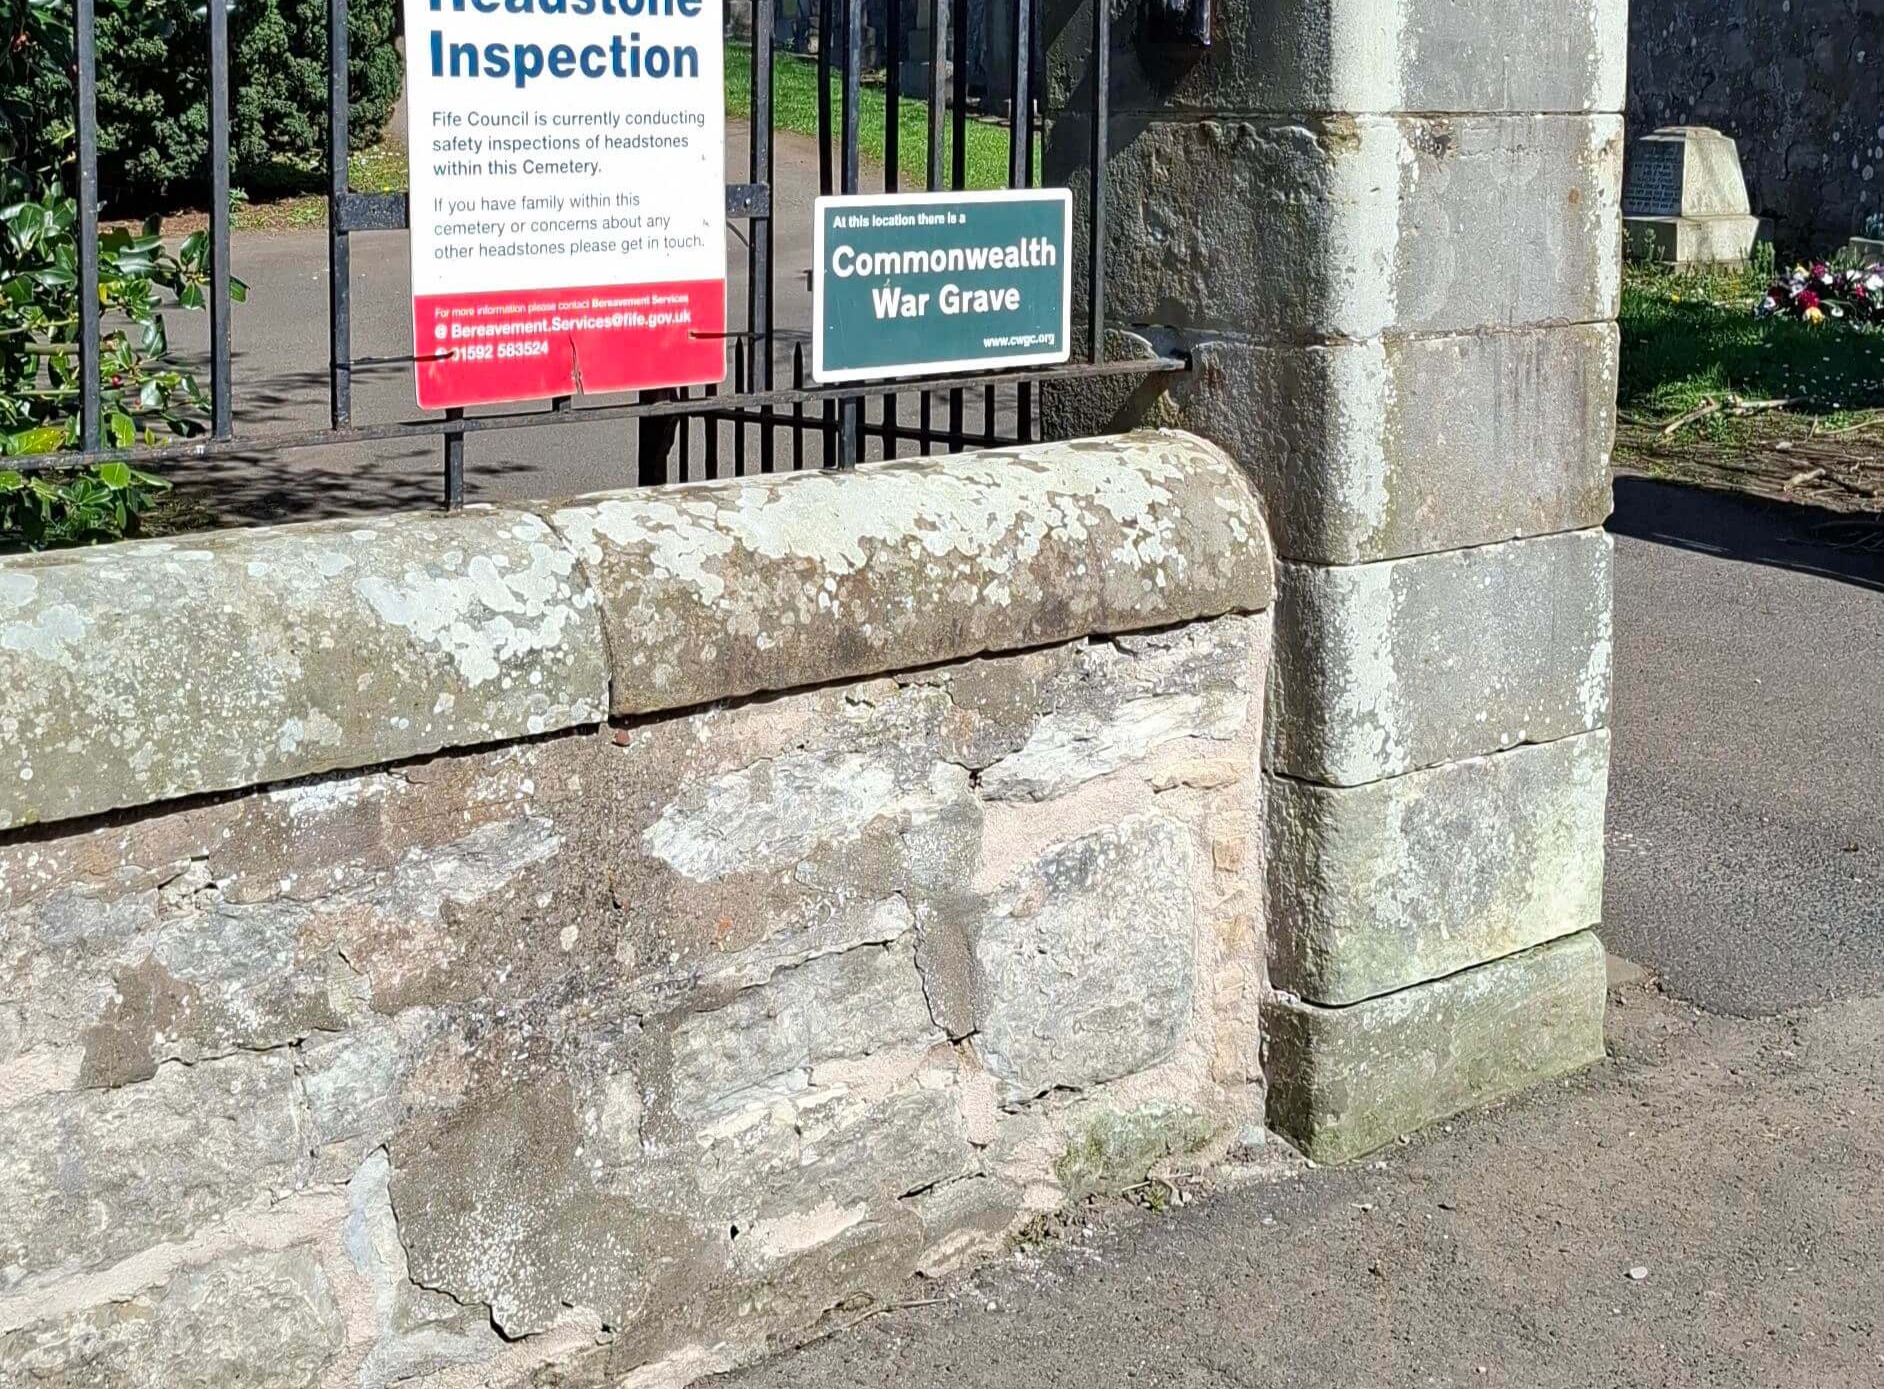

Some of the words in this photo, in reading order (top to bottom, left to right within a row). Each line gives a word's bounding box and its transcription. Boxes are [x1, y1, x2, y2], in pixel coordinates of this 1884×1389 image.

[430, 30, 698, 88] Inspection
[432, 111, 462, 128] Fife
[468, 111, 529, 127] Council
[534, 111, 547, 126] is
[552, 111, 620, 129] currently
[625, 110, 705, 128] conducting
[432, 137, 482, 154] safety
[488, 135, 580, 154] inspections
[585, 134, 600, 150] of
[604, 134, 689, 149] headstones
[433, 161, 482, 177] within
[487, 160, 517, 175] this
[522, 159, 602, 177] Cemetery.
[434, 197, 443, 212] If
[449, 199, 476, 215] you
[481, 196, 516, 212] have
[522, 195, 564, 212] family
[569, 193, 611, 209] within
[615, 192, 640, 207] this
[434, 220, 505, 238] cemetery
[510, 221, 526, 234] or
[530, 218, 597, 233] concerns
[603, 215, 642, 230] about
[646, 216, 671, 230] any
[833, 215, 846, 228] At
[849, 214, 869, 228] this
[873, 212, 915, 227] location
[918, 212, 945, 225] there
[948, 211, 957, 224] is
[959, 214, 966, 224] a
[434, 243, 473, 259] other
[479, 240, 565, 257] headstones
[570, 239, 616, 257] please
[621, 237, 643, 254] get
[647, 236, 659, 250] in
[664, 234, 705, 249] touch.
[832, 237, 1056, 277] Commonwealth
[477, 303, 526, 315] information
[592, 296, 650, 309] Bereavement
[651, 294, 689, 305] Services
[872, 286, 930, 319] War
[939, 283, 1020, 315] Grave
[451, 310, 691, 338] Bereavement.Services@fife.gov.uk
[983, 332, 1055, 349] www.cwgc.org
